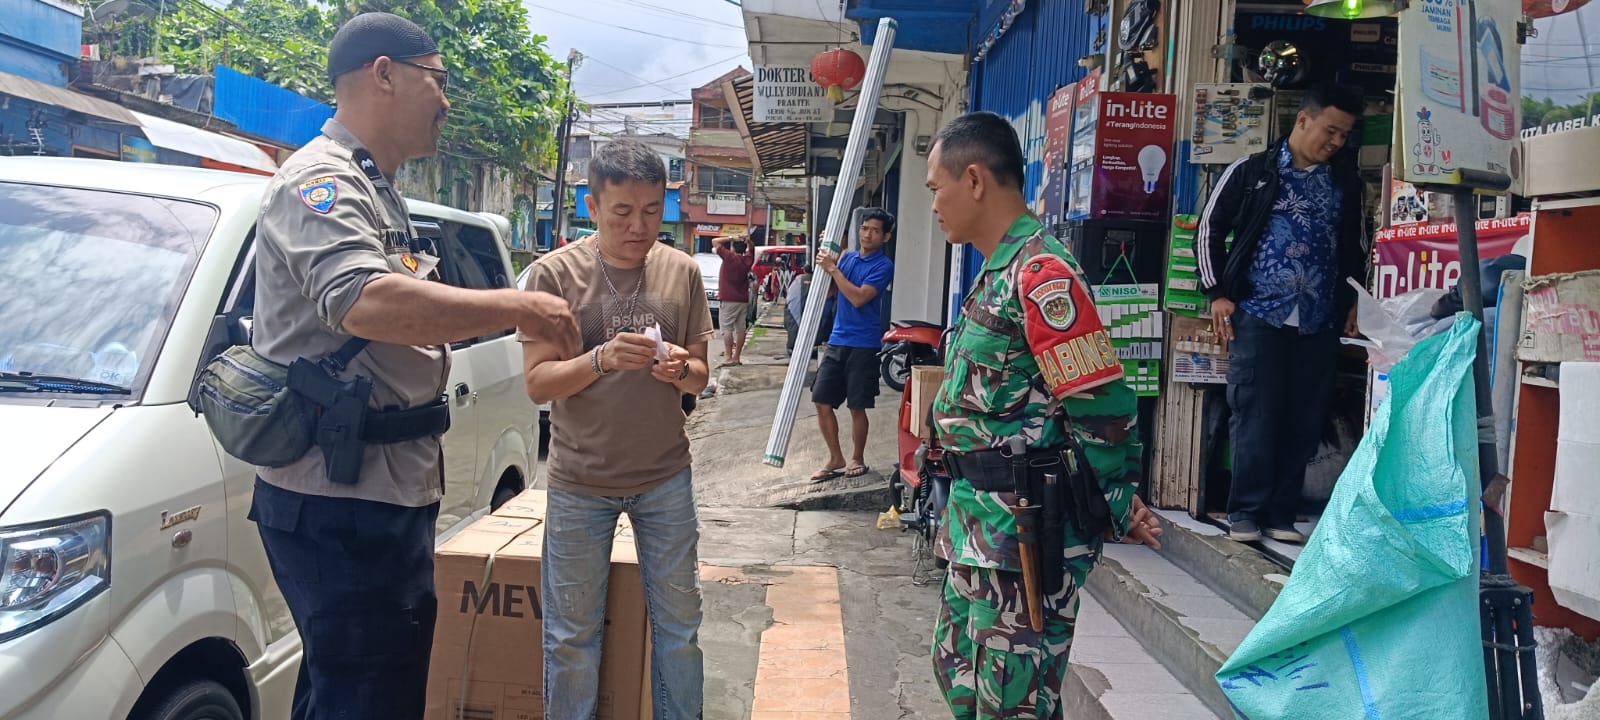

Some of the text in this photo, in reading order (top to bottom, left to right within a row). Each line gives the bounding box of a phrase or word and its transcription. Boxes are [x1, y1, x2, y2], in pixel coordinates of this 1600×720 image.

[1422, 5, 1452, 17] JAMINAN
[1251, 15, 1326, 31] PHILIPS
[758, 67, 805, 83] DOKTER
[757, 85, 828, 98] WILLY BUDIANT
[1105, 121, 1166, 130] #TerangIndonesia
[1111, 287, 1138, 296] NISO
[612, 313, 655, 328] BOMB
